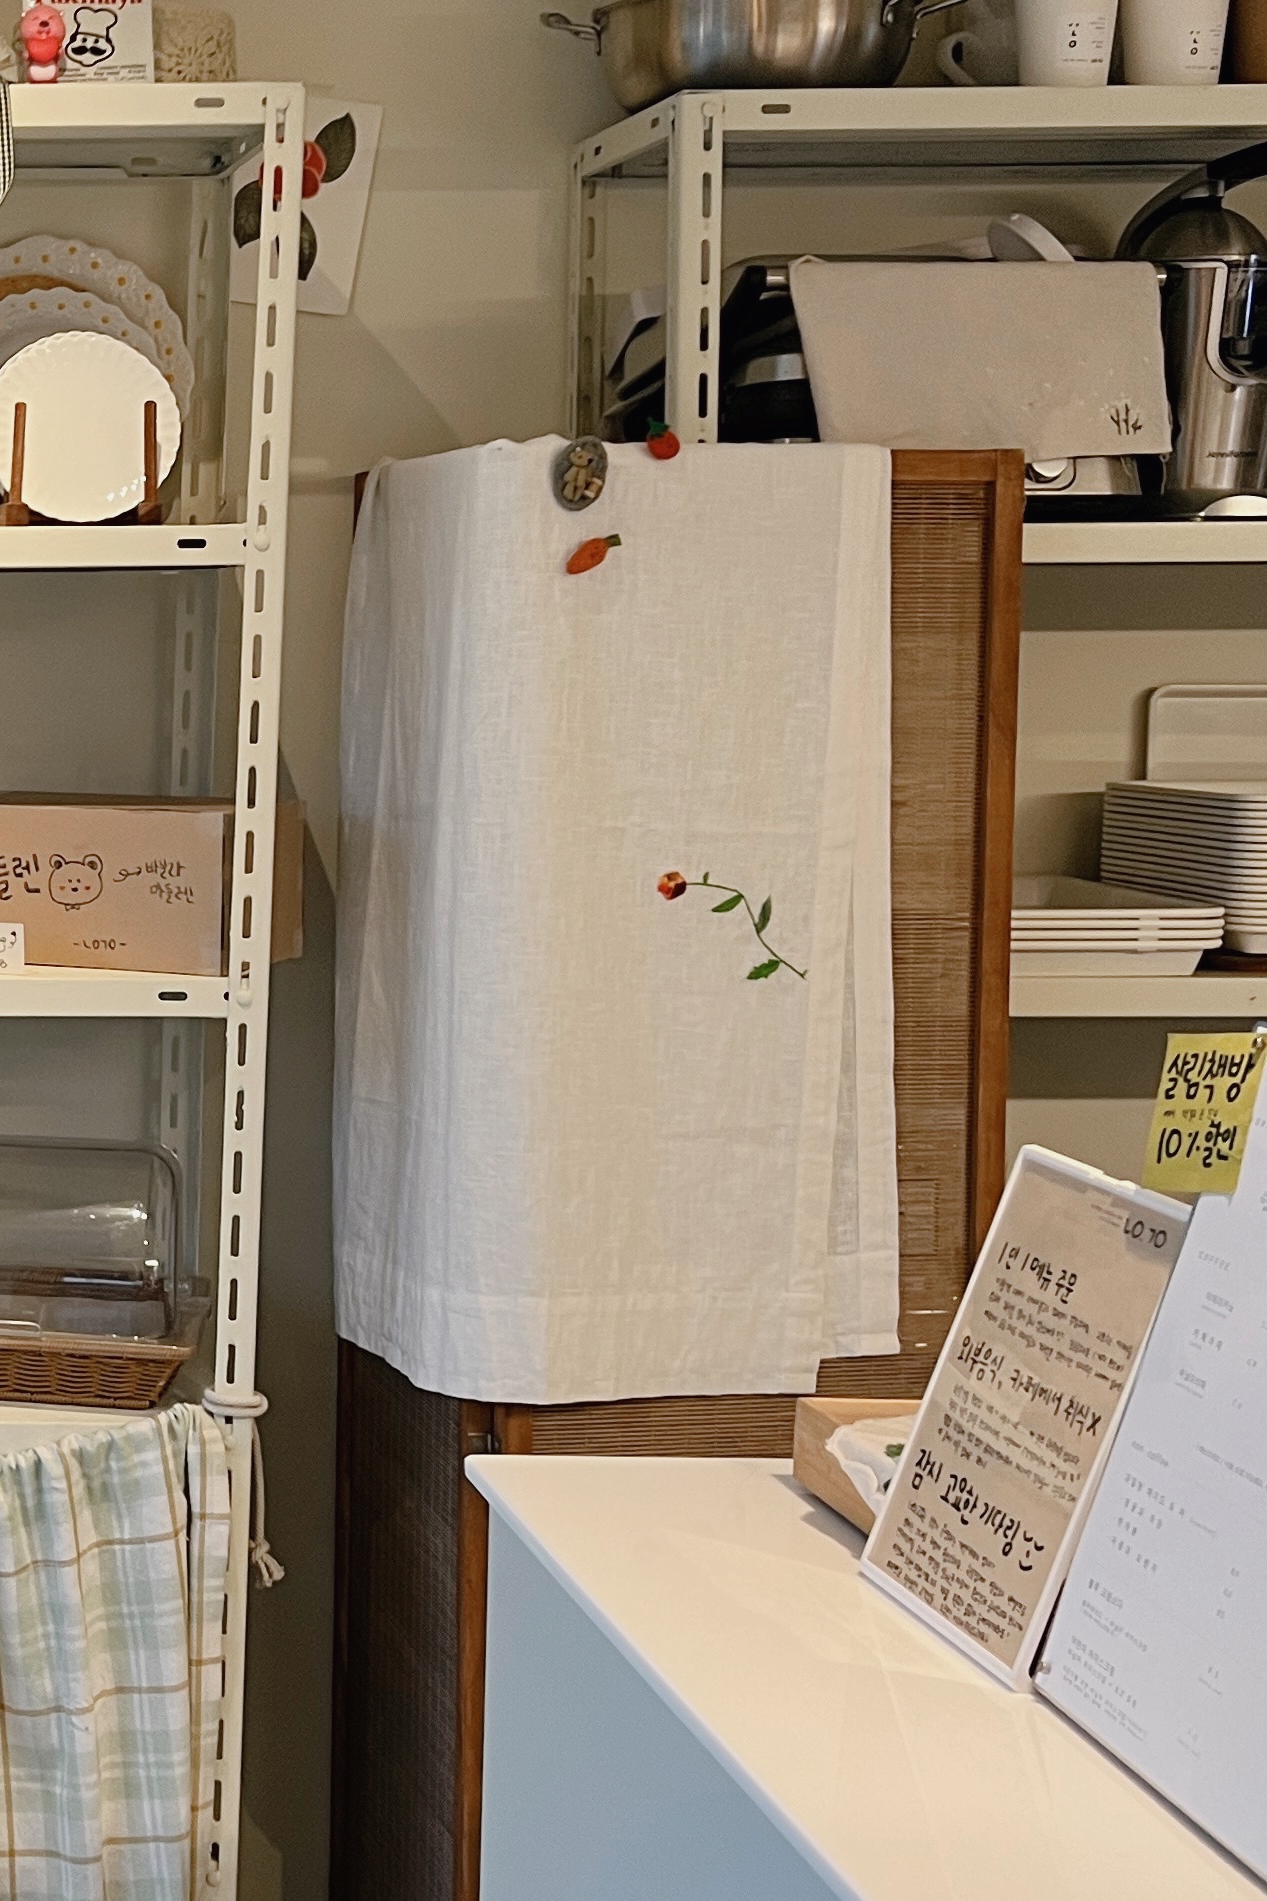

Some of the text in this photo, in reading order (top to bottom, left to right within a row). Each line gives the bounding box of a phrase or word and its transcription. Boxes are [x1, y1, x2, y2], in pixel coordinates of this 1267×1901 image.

[1164, 1049, 1256, 1104] 살림책방
[1156, 1119, 1238, 1169] 10% 할인
[1054, 1268, 1078, 1305] 주문
[1010, 1368, 1065, 1416] 카페에서
[911, 1448, 944, 1491] 잠시
